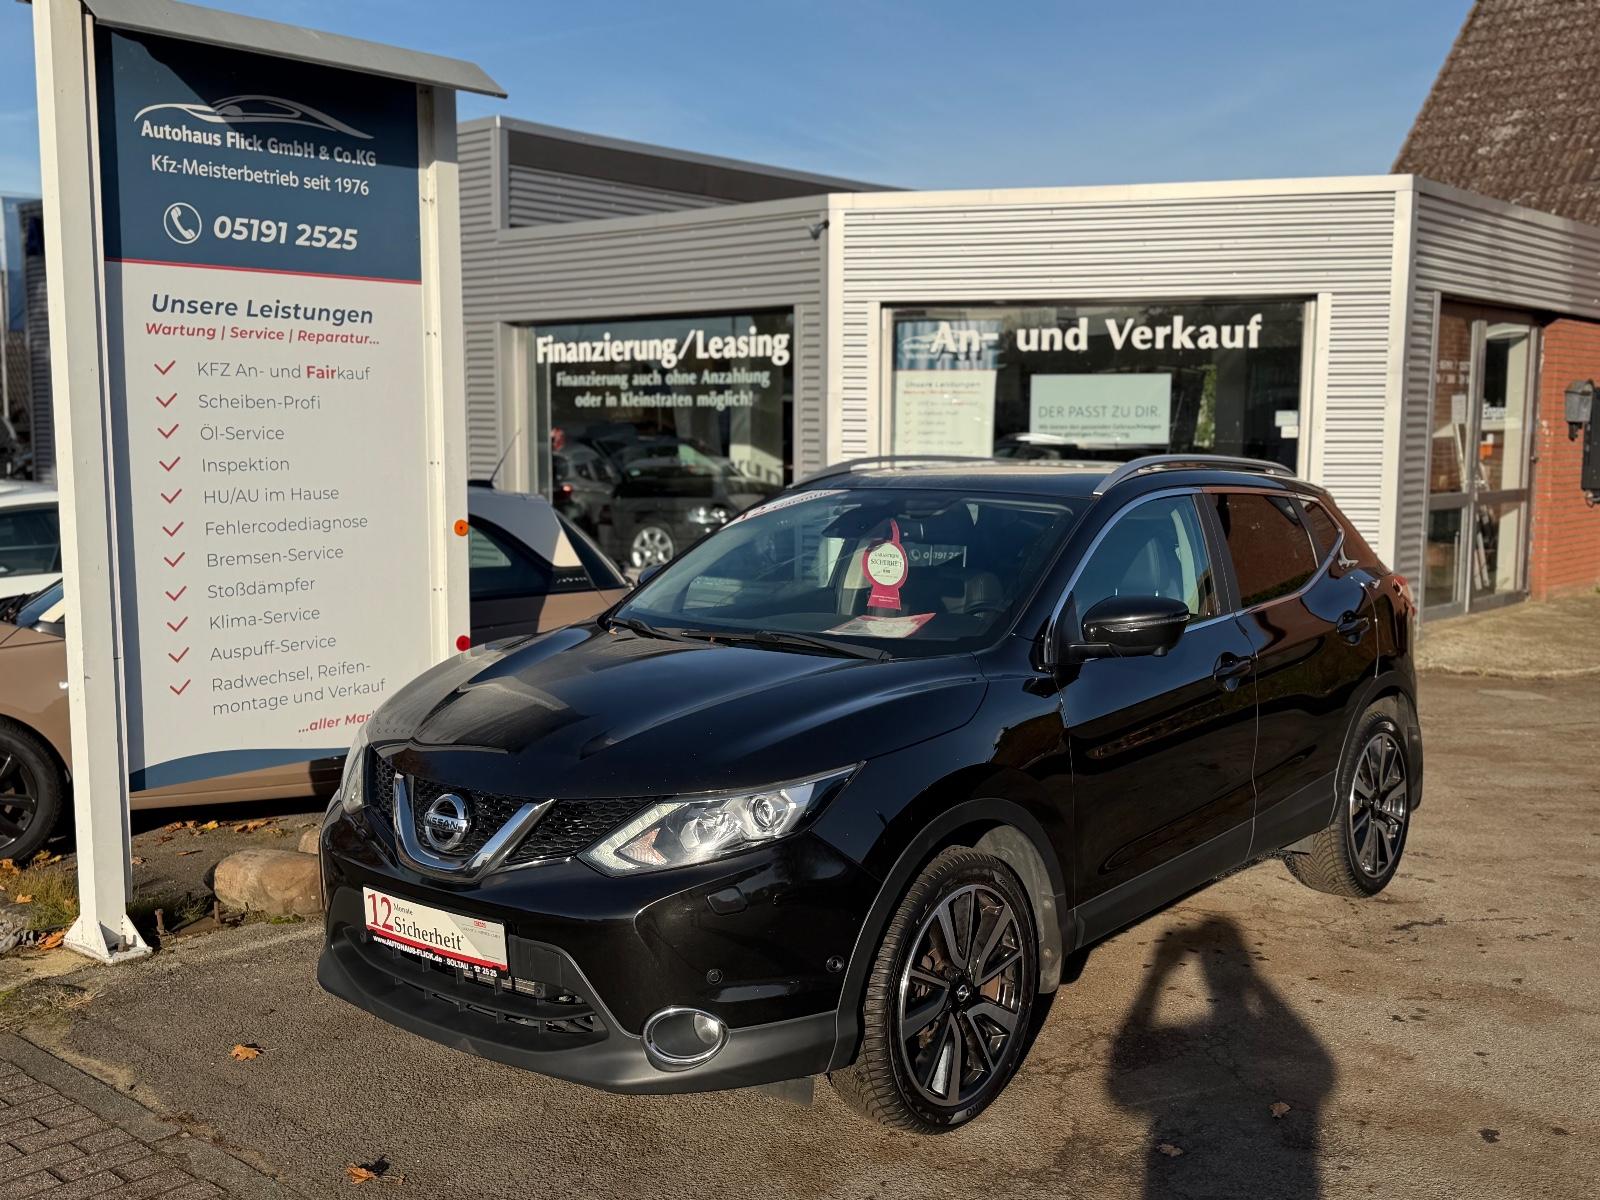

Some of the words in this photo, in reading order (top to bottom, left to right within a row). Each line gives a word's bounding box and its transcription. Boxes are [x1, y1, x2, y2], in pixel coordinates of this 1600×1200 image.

[141, 119, 222, 147] Autohaus
[226, 131, 263, 153] Flick
[267, 138, 315, 159] GmbH
[319, 145, 330, 161] &
[333, 146, 377, 167] Co.KG
[151, 154, 300, 188] Kfz-Meisterbetrieb
[303, 174, 331, 192] seit
[334, 177, 370, 196] 1976
[213, 215, 288, 244] 05191
[295, 224, 358, 251] 2525
[152, 293, 239, 317] Unsere
[246, 299, 373, 327] Leistungen
[146, 322, 216, 340] Wartung
[230, 326, 285, 341] Service
[297, 330, 380, 346] Reparatur...
[930, 320, 999, 353] An-
[1016, 317, 1088, 351] und
[1105, 313, 1262, 350] Verkauf
[536, 325, 790, 369] Finanzierung/Leasing
[197, 362, 231, 378] KFZ
[235, 363, 264, 378] An-
[269, 364, 301, 379] und
[306, 365, 371, 381] Fairkauf
[556, 371, 629, 391] Finanzierung
[632, 369, 661, 386] auch
[665, 368, 697, 385] ohne
[701, 368, 771, 389] Anzahlung
[198, 394, 321, 410] Scheiben-Profi
[575, 393, 602, 408] oder
[605, 392, 617, 408] in
[621, 391, 693, 408] Kleinstraten
[696, 390, 753, 411] möglich!
[1039, 405, 1065, 418] DER
[1068, 405, 1108, 418] PASST
[1112, 405, 1131, 418] ZU
[200, 423, 285, 441] Öl-Service
[202, 457, 290, 475] Inspektion
[204, 487, 259, 505] HU/AU
[264, 488, 286, 502] im
[290, 487, 340, 501] Hause
[205, 516, 369, 536] Fehlercodediagnose
[207, 545, 344, 568] Bremsen-Service
[207, 577, 316, 599] Stoßdämpfer
[209, 607, 321, 630] Klima-Service
[210, 635, 337, 661] Auspuff-Service
[212, 667, 313, 692] Radwechsel,
[318, 660, 371, 679] Reifen-
[213, 695, 288, 716] montage
[293, 687, 324, 704] und
[328, 679, 387, 699] Verkauf
[298, 716, 341, 733] ...aller
[345, 710, 375, 726] Mar
[426, 813, 459, 830] NISSAN
[367, 893, 394, 932] 12
[447, 957, 469, 970] SOLTAU
